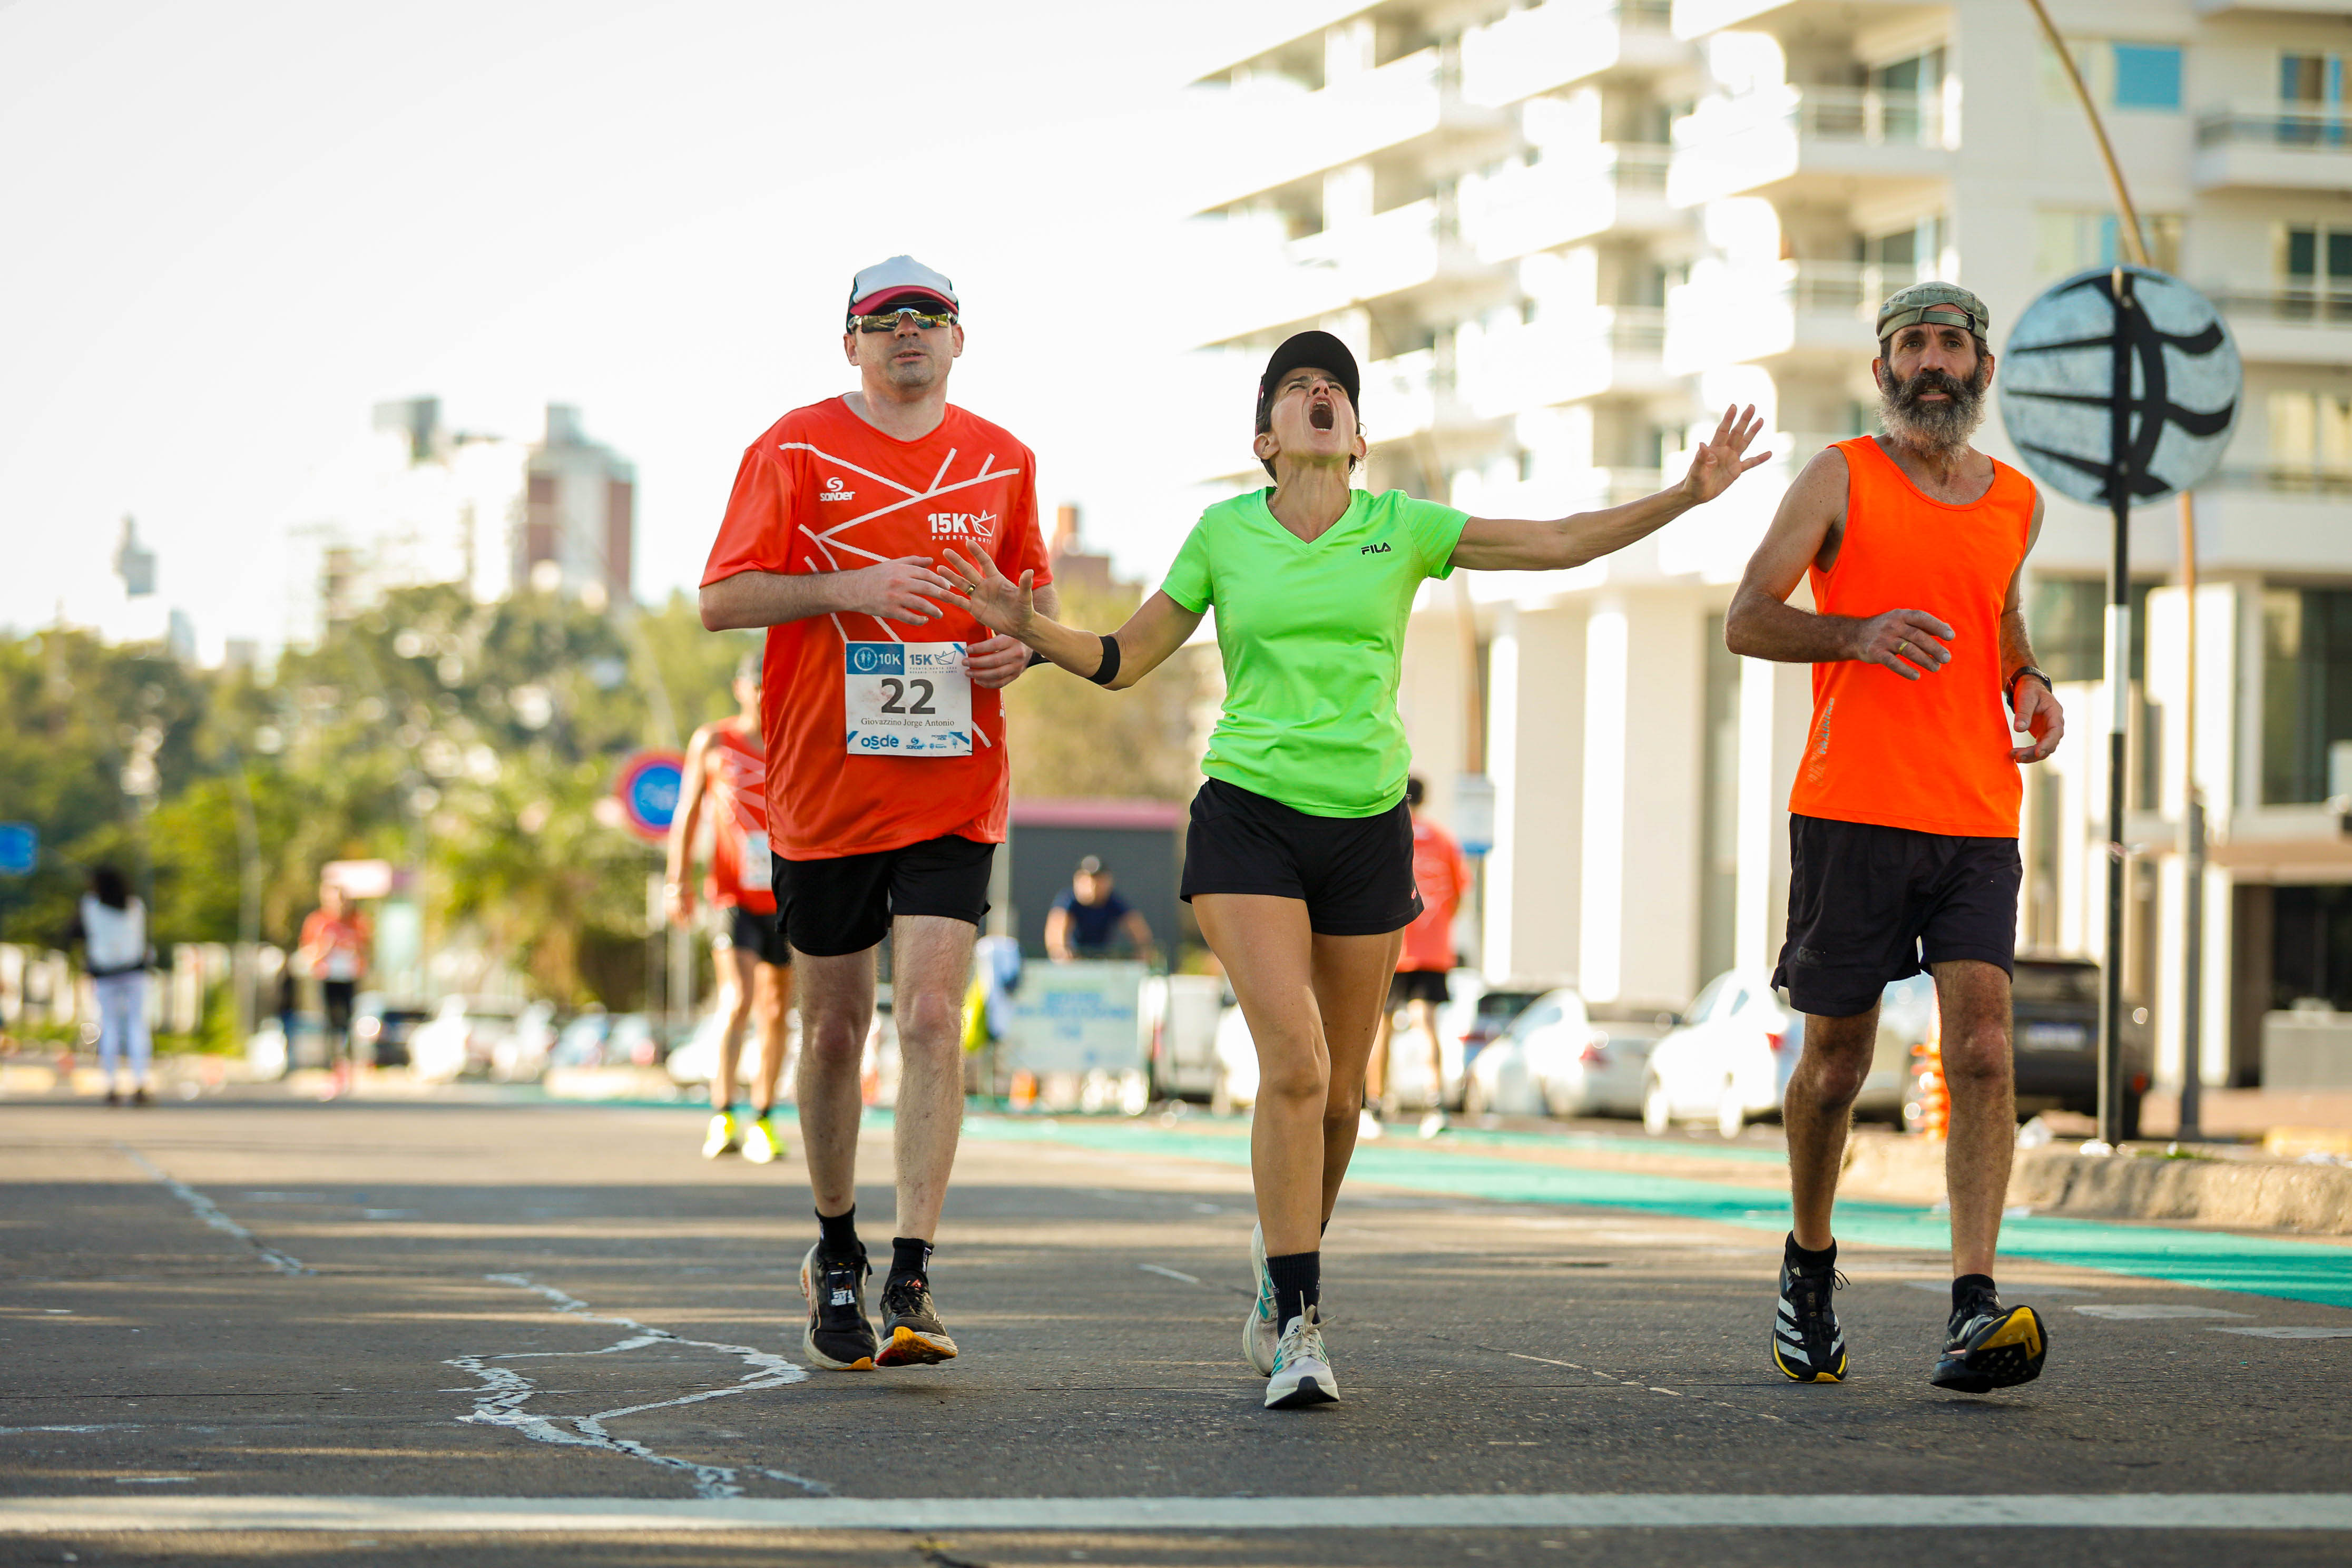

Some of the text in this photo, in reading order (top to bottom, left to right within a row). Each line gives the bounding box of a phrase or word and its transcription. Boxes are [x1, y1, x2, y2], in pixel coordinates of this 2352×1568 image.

[927, 513, 969, 533] 15K
[1361, 542, 1391, 555] FILA
[878, 653, 901, 665] 10K
[910, 654, 933, 665] 15K
[881, 678, 936, 714] 22
[903, 719, 923, 728] Jorge
[1820, 698, 1835, 754] TRAINING
[861, 734, 899, 749] osde
